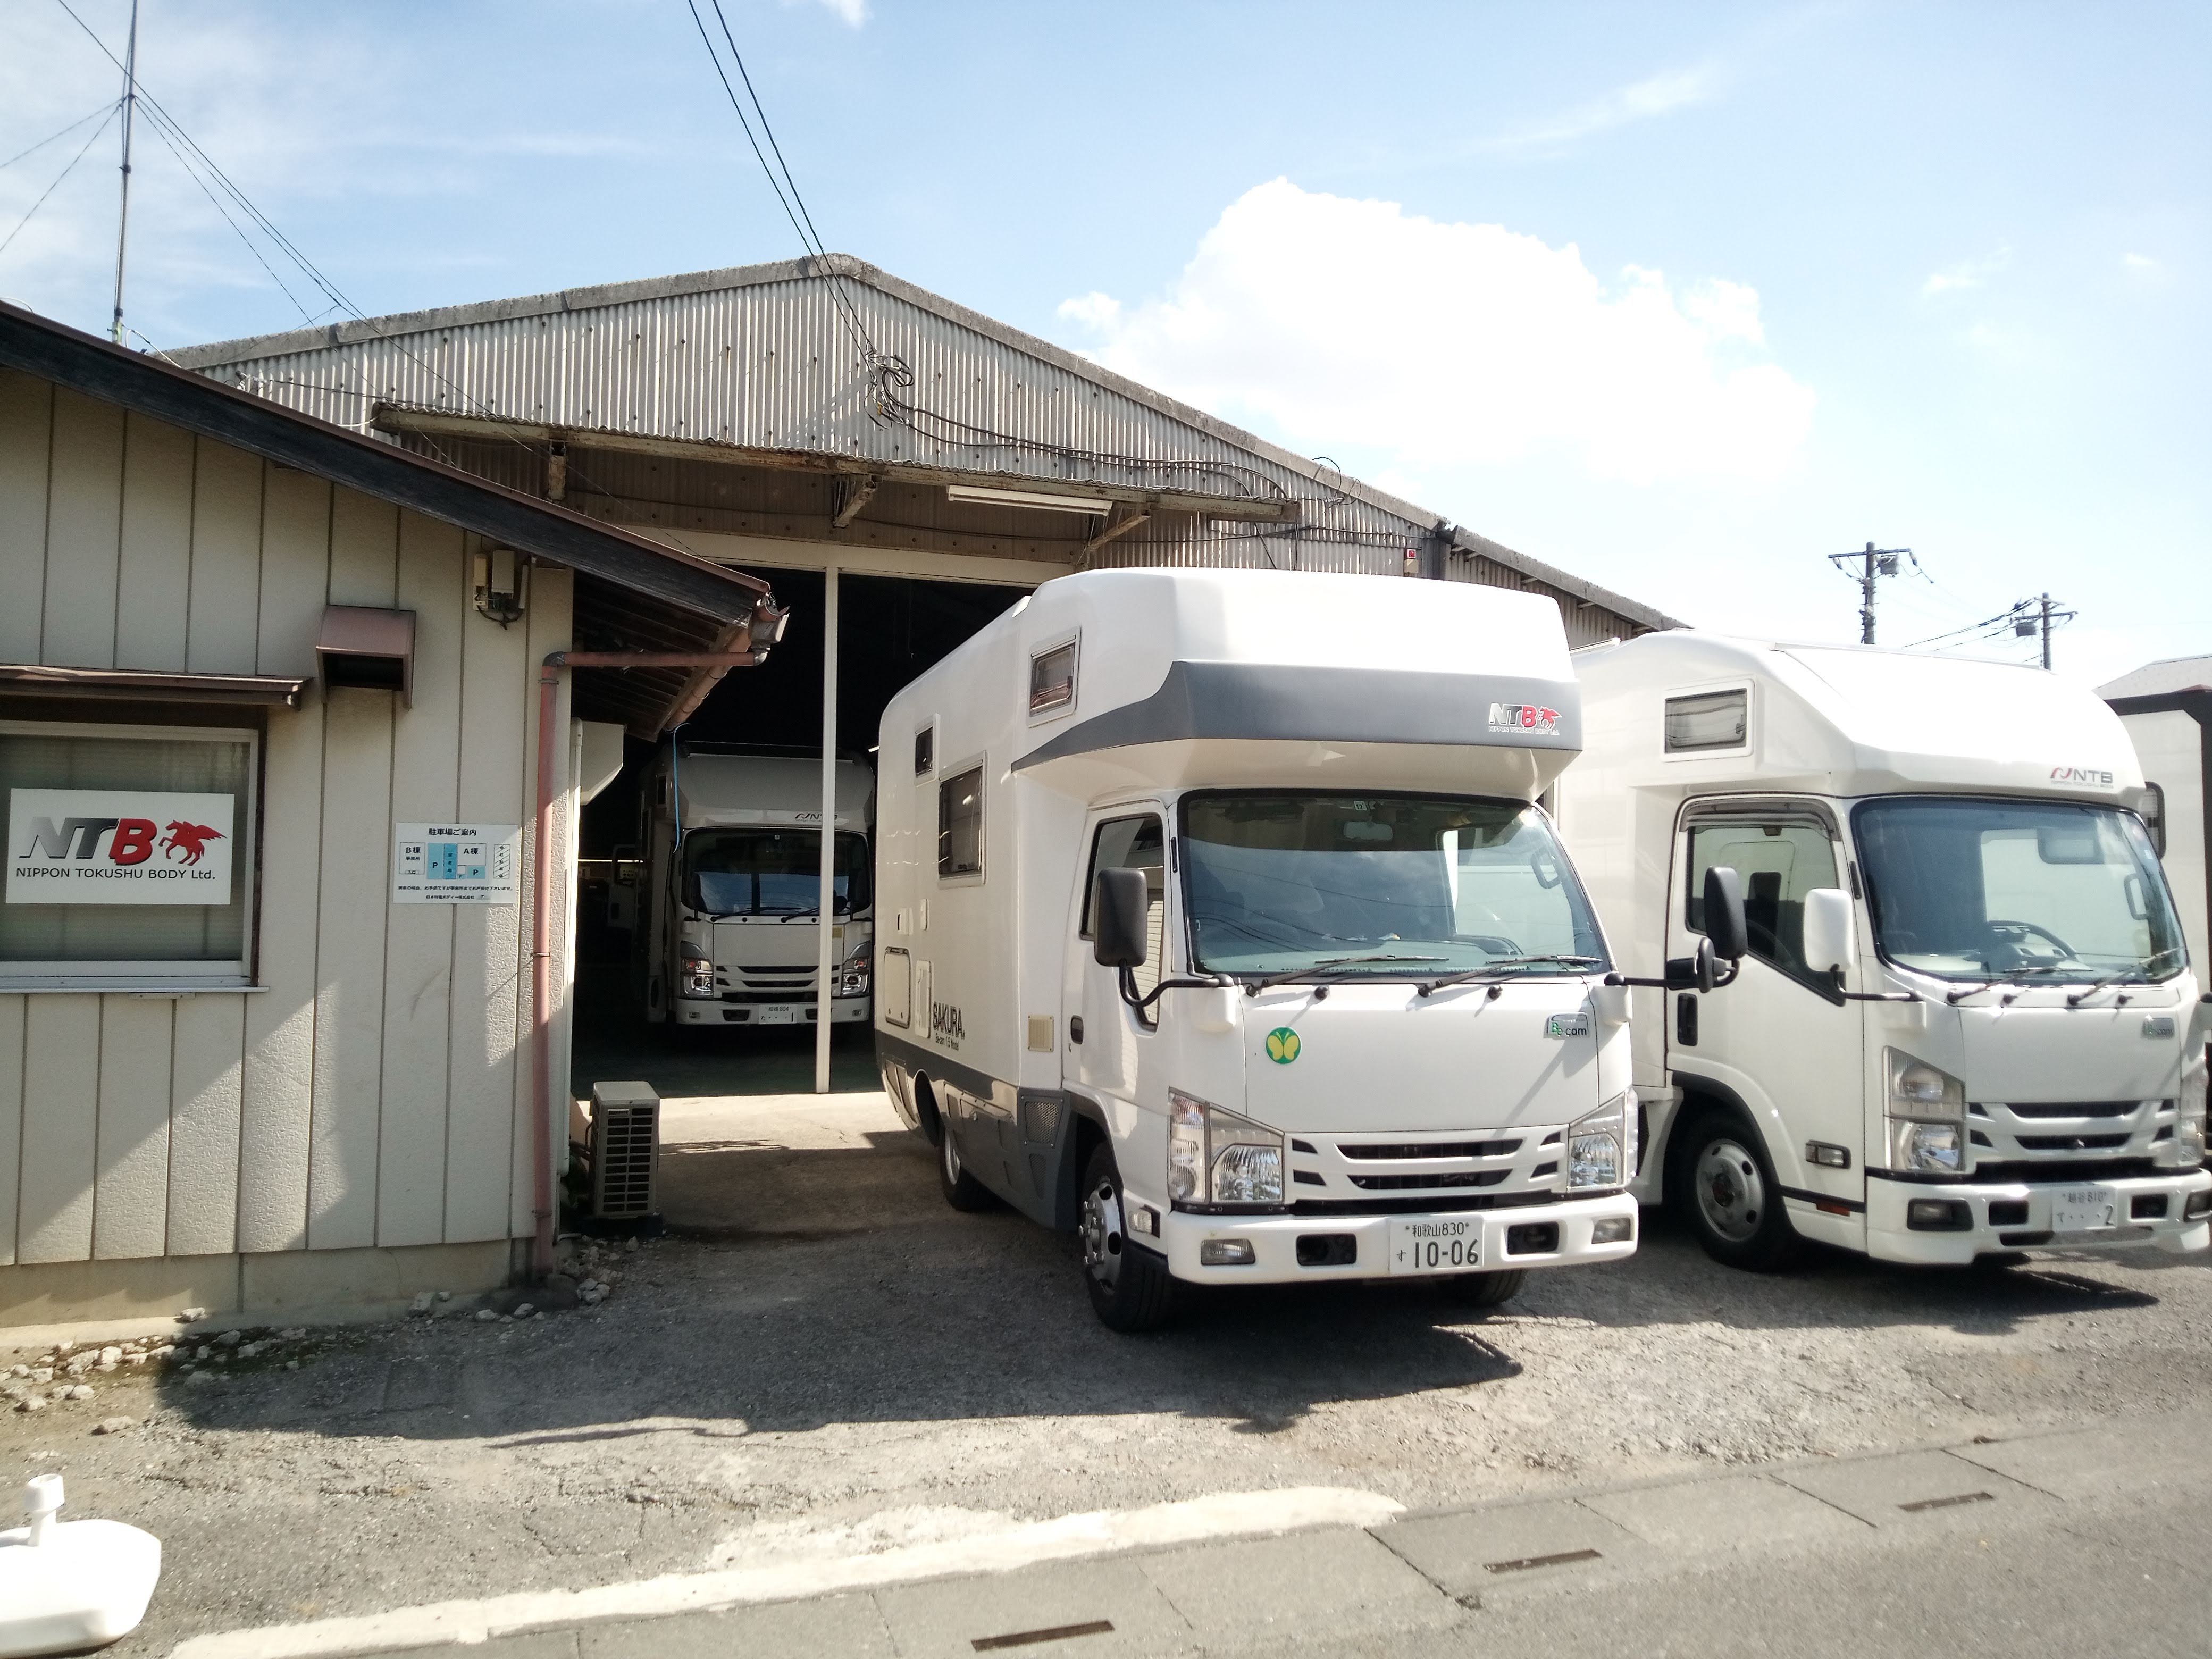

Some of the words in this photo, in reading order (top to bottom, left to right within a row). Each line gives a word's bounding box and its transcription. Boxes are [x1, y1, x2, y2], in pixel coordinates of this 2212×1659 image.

[1489, 703, 1538, 727] NTB
[2074, 769, 2113, 783] NTB
[19, 817, 157, 865] NTB
[16, 868, 70, 877] NIPPON
[76, 868, 143, 878] TOKUSHU
[149, 869, 186, 879] BODY
[191, 870, 216, 879] Ltd.
[1412, 1222, 1464, 1237] 和歌山830
[1397, 1250, 1406, 1262] す
[1415, 1238, 1479, 1268] 10-06
